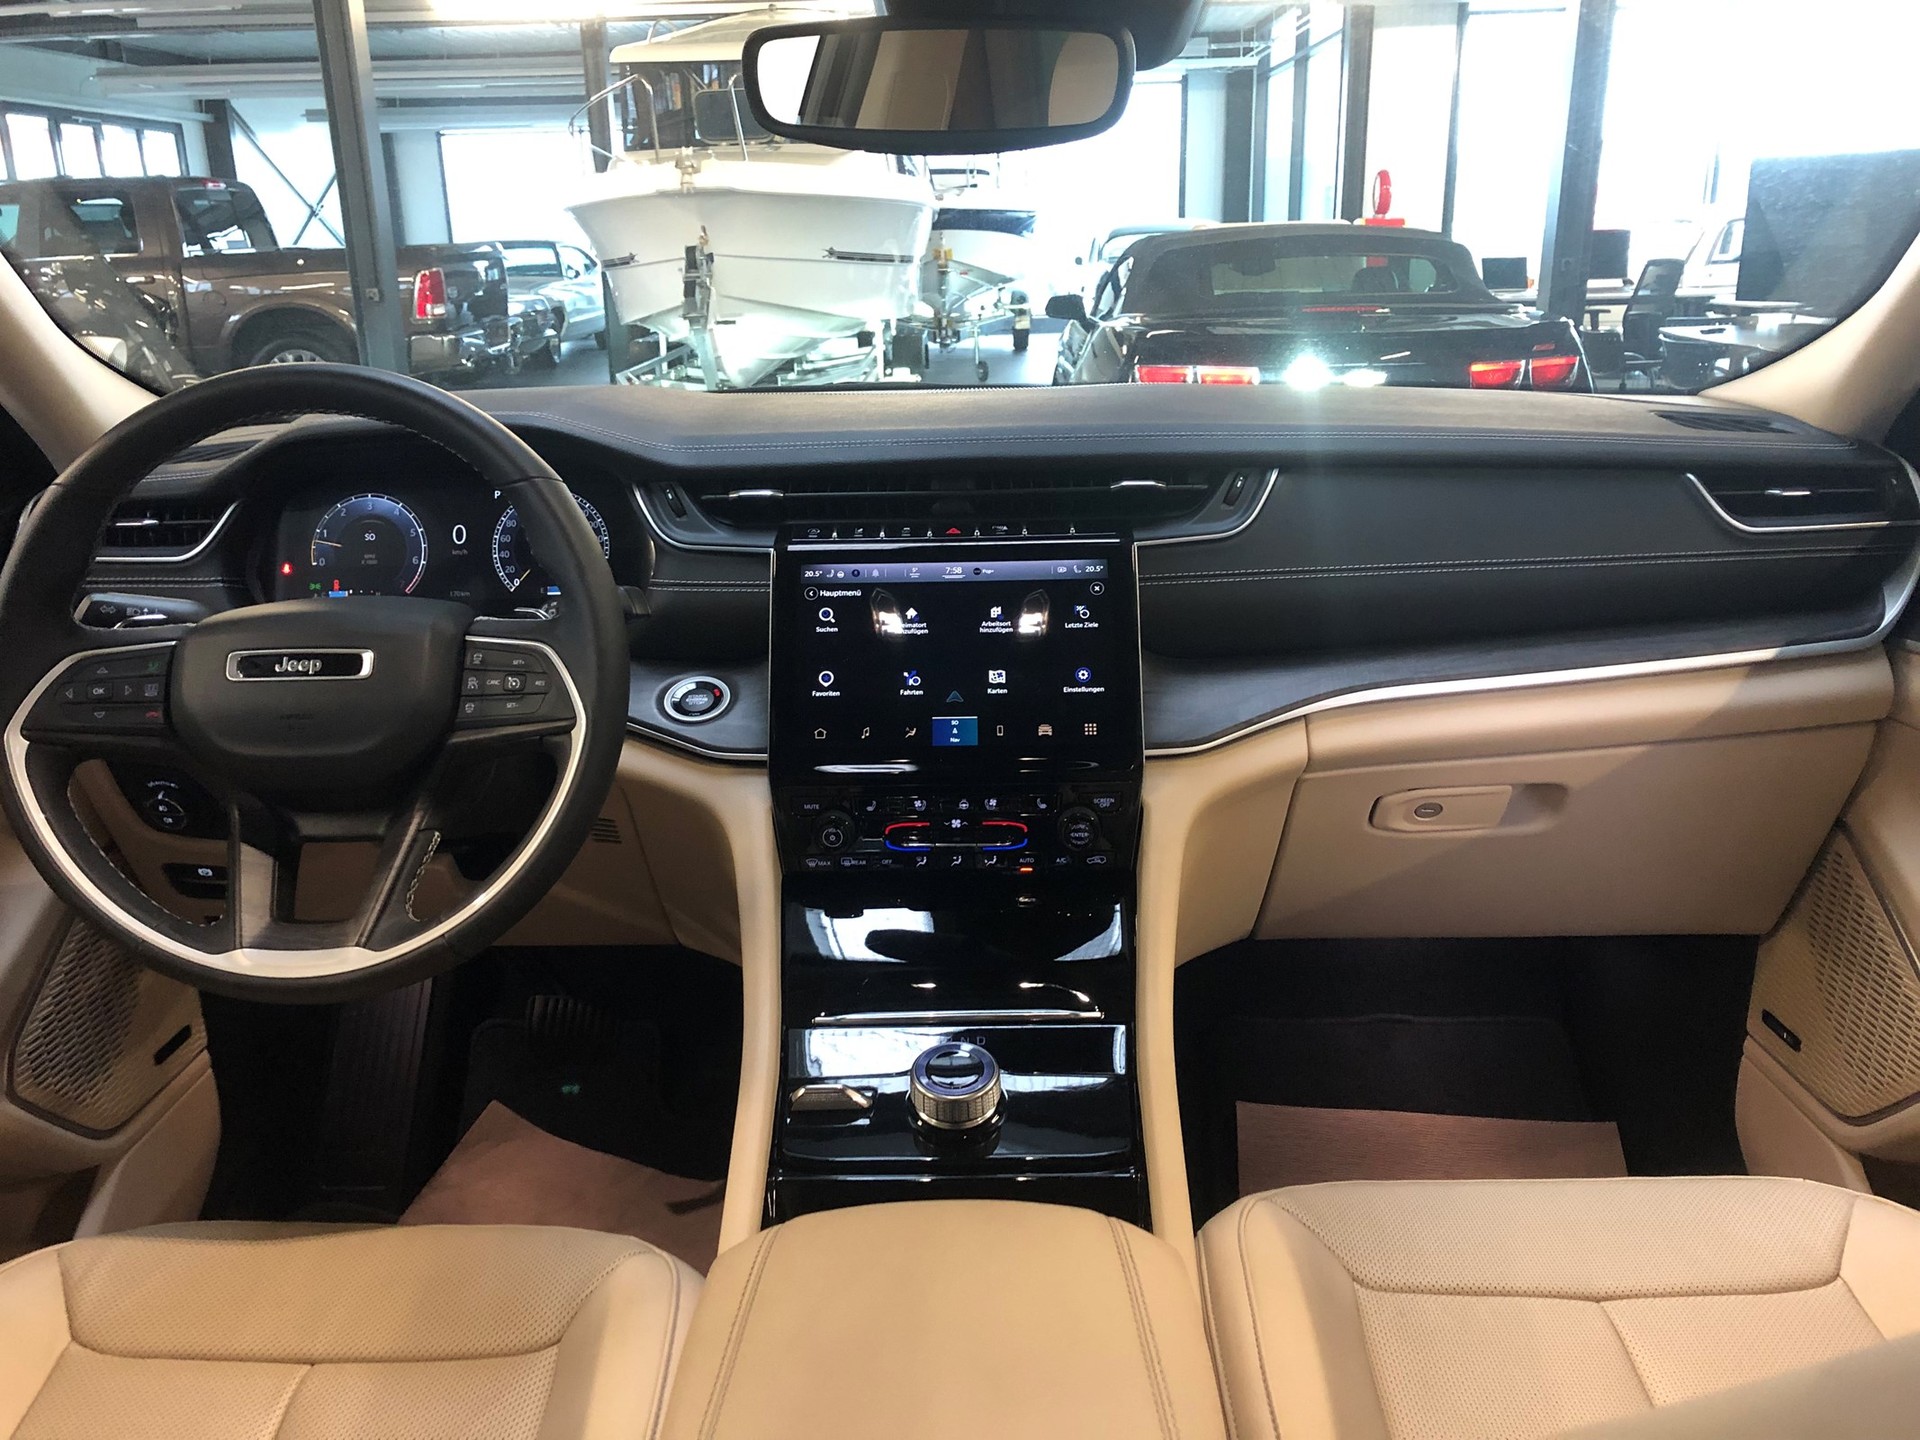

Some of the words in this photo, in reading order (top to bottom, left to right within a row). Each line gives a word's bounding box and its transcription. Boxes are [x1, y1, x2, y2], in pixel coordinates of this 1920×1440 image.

[494, 490, 501, 499] P
[367, 502, 373, 510] 3
[340, 508, 347, 516] 2
[393, 508, 400, 516] 4
[505, 519, 516, 528] 80
[322, 529, 328, 538] 1
[409, 528, 416, 537] 5
[452, 524, 467, 545] 0
[500, 534, 511, 543] 60
[499, 550, 510, 558] 40
[318, 558, 326, 567] 0
[412, 555, 419, 564] 6
[505, 565, 516, 574] 20
[945, 566, 963, 574] 7:58
[1085, 565, 1104, 573] 20.5°
[804, 570, 823, 578] 20.5°
[513, 578, 520, 586] 0
[820, 589, 862, 598] Hauptmenü
[274, 656, 323, 675] Jeep
[92, 687, 106, 695] OK
[976, 1036, 986, 1045] D
